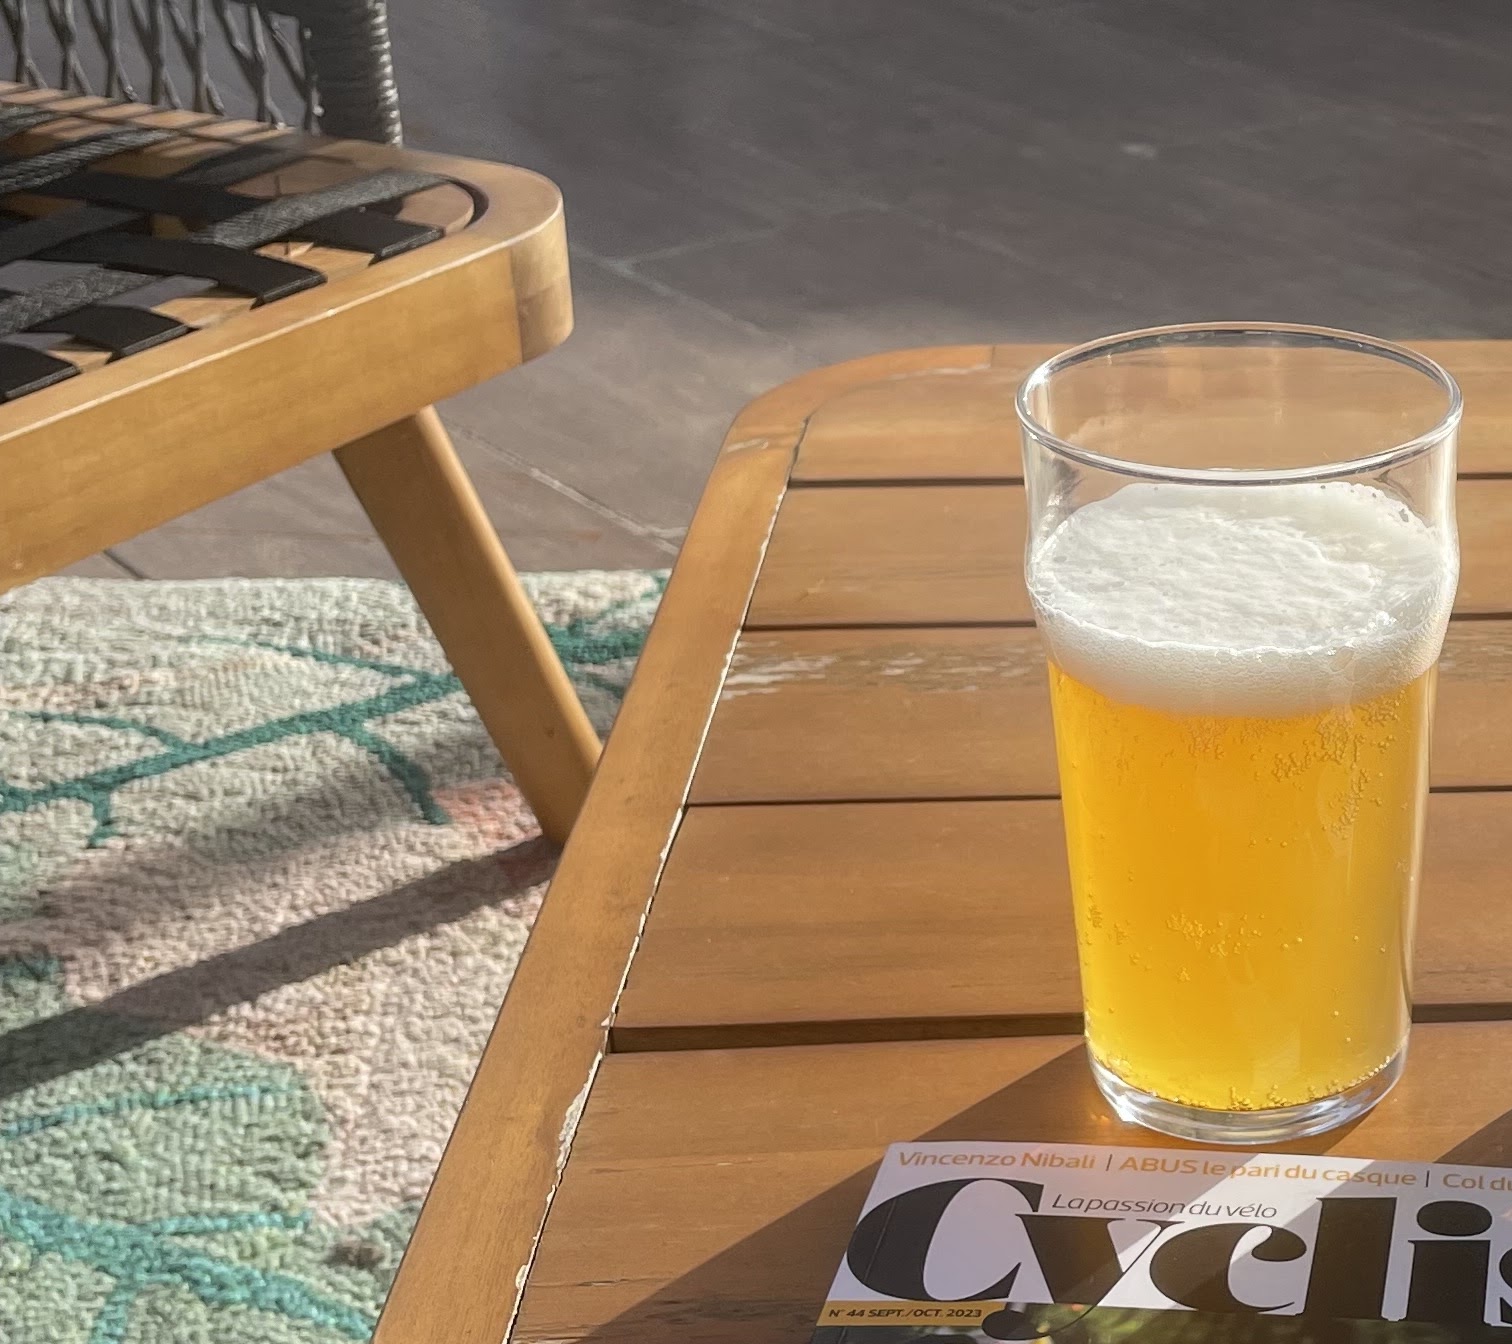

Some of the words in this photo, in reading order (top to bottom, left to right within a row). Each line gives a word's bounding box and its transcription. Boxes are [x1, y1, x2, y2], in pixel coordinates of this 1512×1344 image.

[898, 1151, 1016, 1167] Vincenzo
[1020, 1151, 1096, 1169] Nibali
[1119, 1156, 1199, 1174] ABUS
[1203, 1159, 1225, 1175] le
[1228, 1164, 1281, 1183] pari
[1284, 1163, 1317, 1180] du
[1322, 1168, 1417, 1187] casque
[1442, 1172, 1484, 1190] Col
[1052, 1194, 1083, 1210] La
[1083, 1196, 1186, 1214] passion
[1189, 1199, 1223, 1217] du
[1226, 1202, 1278, 1219] vélo
[846, 1308, 865, 1318] 44
[946, 1308, 983, 1318] 2023
